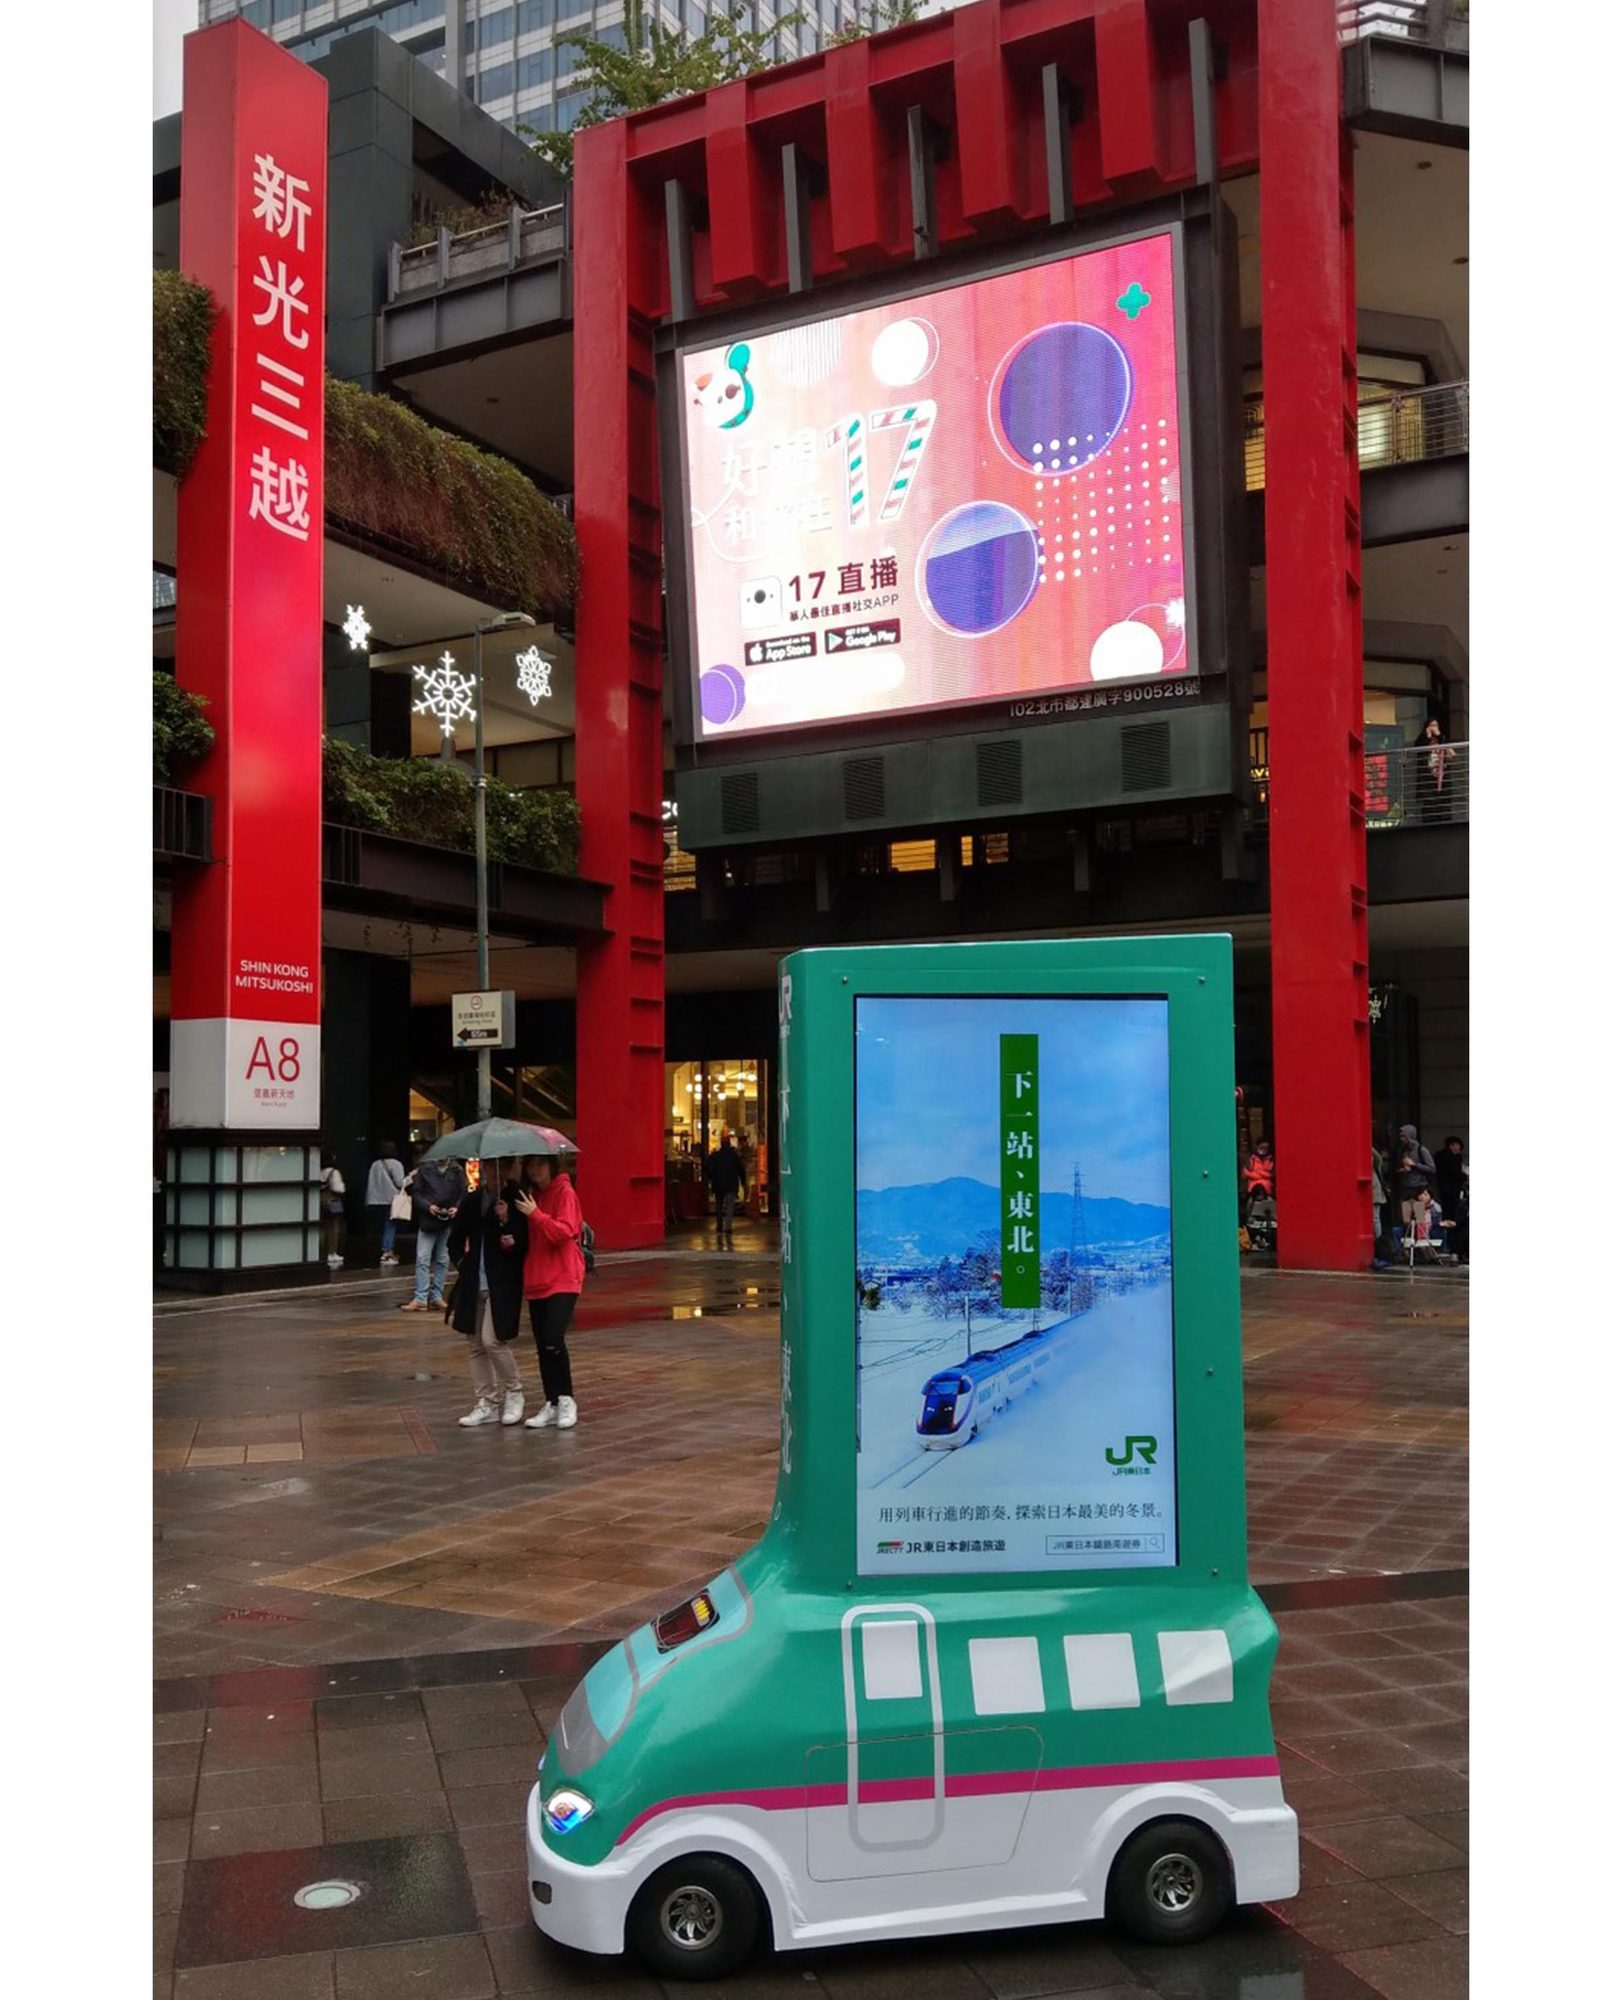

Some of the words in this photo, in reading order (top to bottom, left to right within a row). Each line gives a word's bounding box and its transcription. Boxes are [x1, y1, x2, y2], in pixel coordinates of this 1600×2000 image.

[249, 153, 312, 541] 新光三越
[789, 571, 826, 602] 17
[837, 555, 898, 595] 直播
[765, 648, 785, 661] App
[786, 645, 812, 657] Store
[240, 960, 271, 974] SHIN
[273, 963, 309, 977] KONG
[235, 975, 314, 994] MITSUKOSHI
[245, 1036, 300, 1082] A8
[1006, 1070, 1035, 1274] 下一站、東北。
[1105, 1435, 1158, 1466] JR
[906, 1540, 1006, 1554] JR東日本創造旅遊
